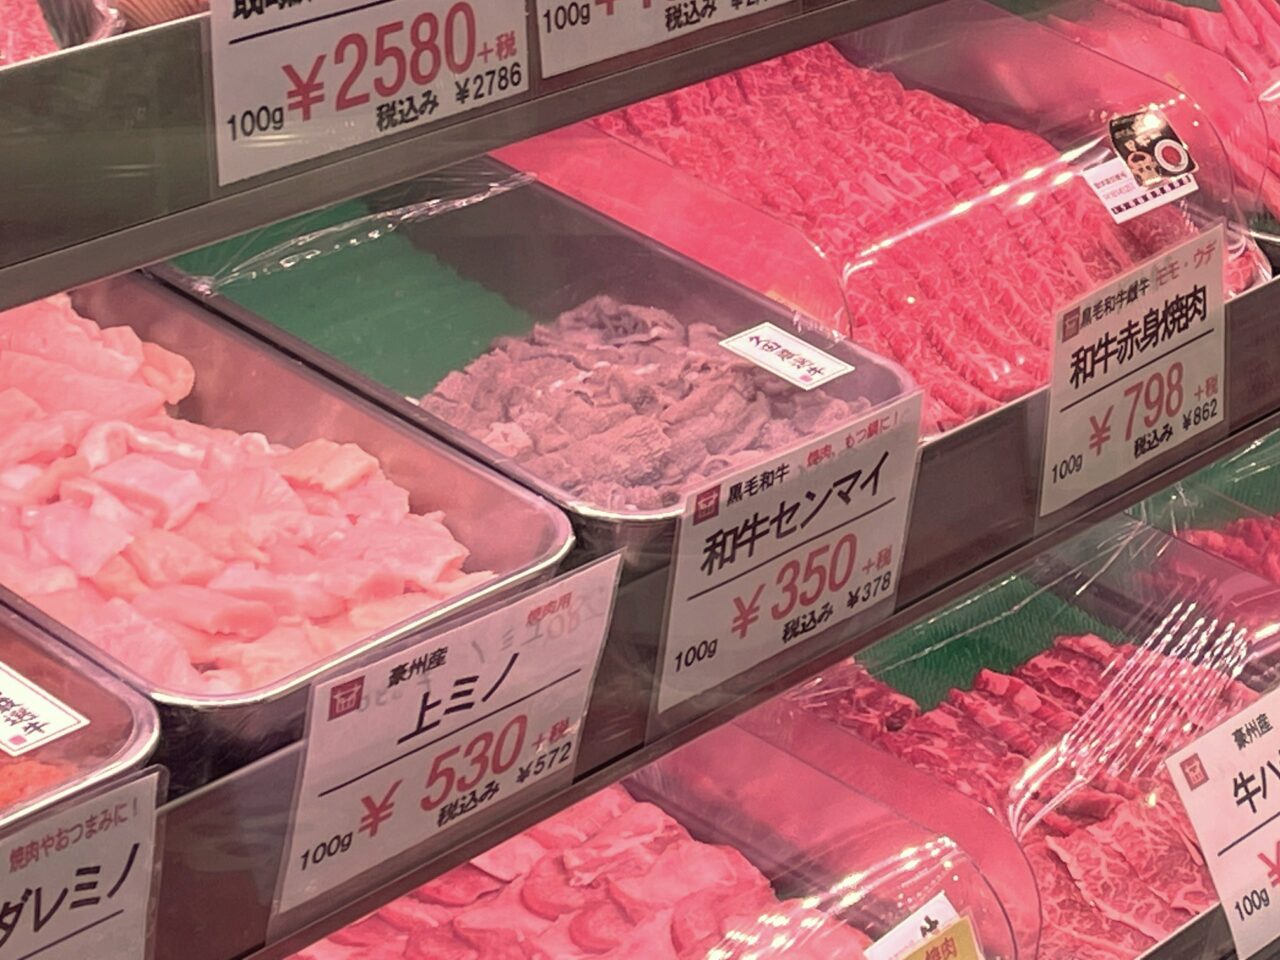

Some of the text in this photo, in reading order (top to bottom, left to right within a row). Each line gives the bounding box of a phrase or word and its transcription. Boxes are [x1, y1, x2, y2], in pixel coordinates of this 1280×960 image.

[543, 2, 590, 33] 100g
[227, 105, 284, 140] 100g
[281, 2, 476, 122] ¥2580
[376, 62, 521, 131] 税込み ¥2786
[1070, 284, 1207, 391] 和牛赤身焼肉
[1080, 277, 1151, 329] 黒毛和牛雌牛
[1051, 453, 1083, 484] 100g
[1088, 361, 1185, 457] ¥798
[1134, 398, 1218, 460] 税込み ¥862
[701, 451, 889, 576] 和牛センマイ
[727, 463, 790, 507] 黒毛和牛
[674, 638, 718, 673] 100g
[731, 533, 856, 638] ¥350
[782, 571, 891, 643] 税込み ¥378
[388, 647, 448, 688] 豪州産
[397, 653, 519, 744] 上ミノ
[1232, 713, 1273, 750] 豪州産
[300, 833, 352, 870] 100g
[358, 714, 527, 838] ¥530
[438, 742, 572, 827] 税込み ¥572
[1235, 888, 1270, 921] 100g
